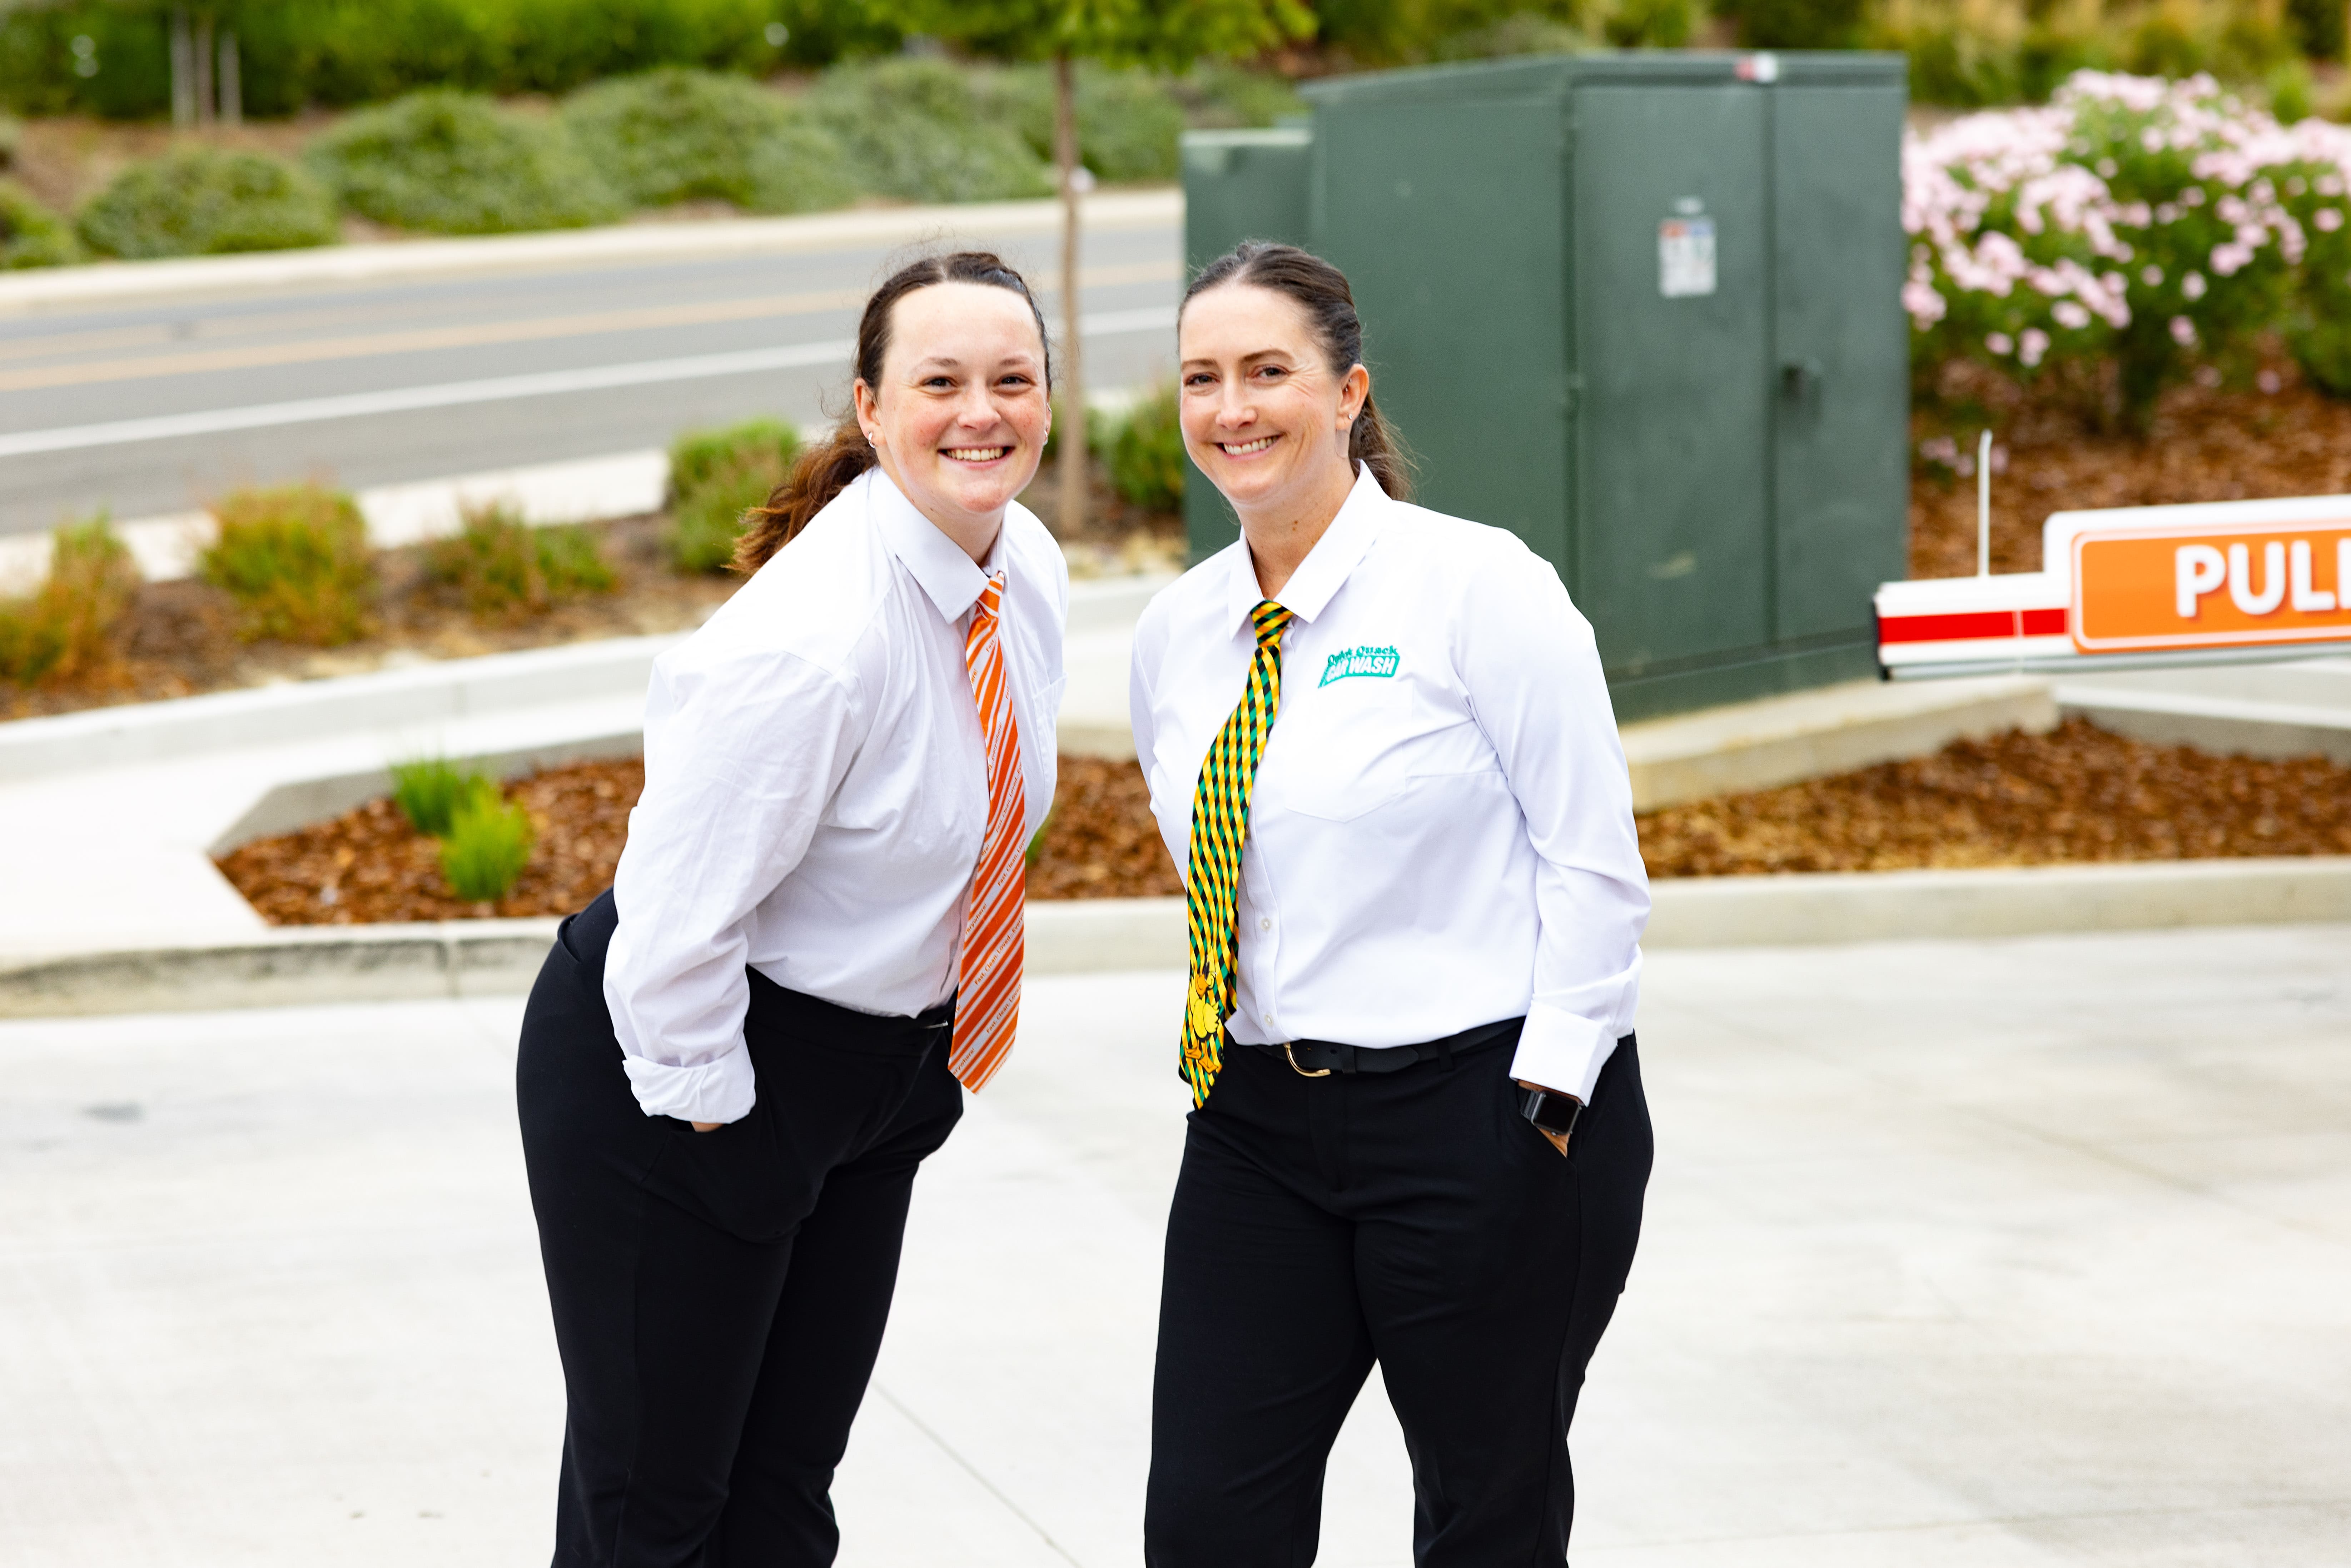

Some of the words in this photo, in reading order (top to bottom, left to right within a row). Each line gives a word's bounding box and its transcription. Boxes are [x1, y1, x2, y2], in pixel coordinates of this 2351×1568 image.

[1356, 645, 1398, 657] Quack
[1326, 659, 1349, 682] CAR
[1348, 656, 1396, 675] WASH
